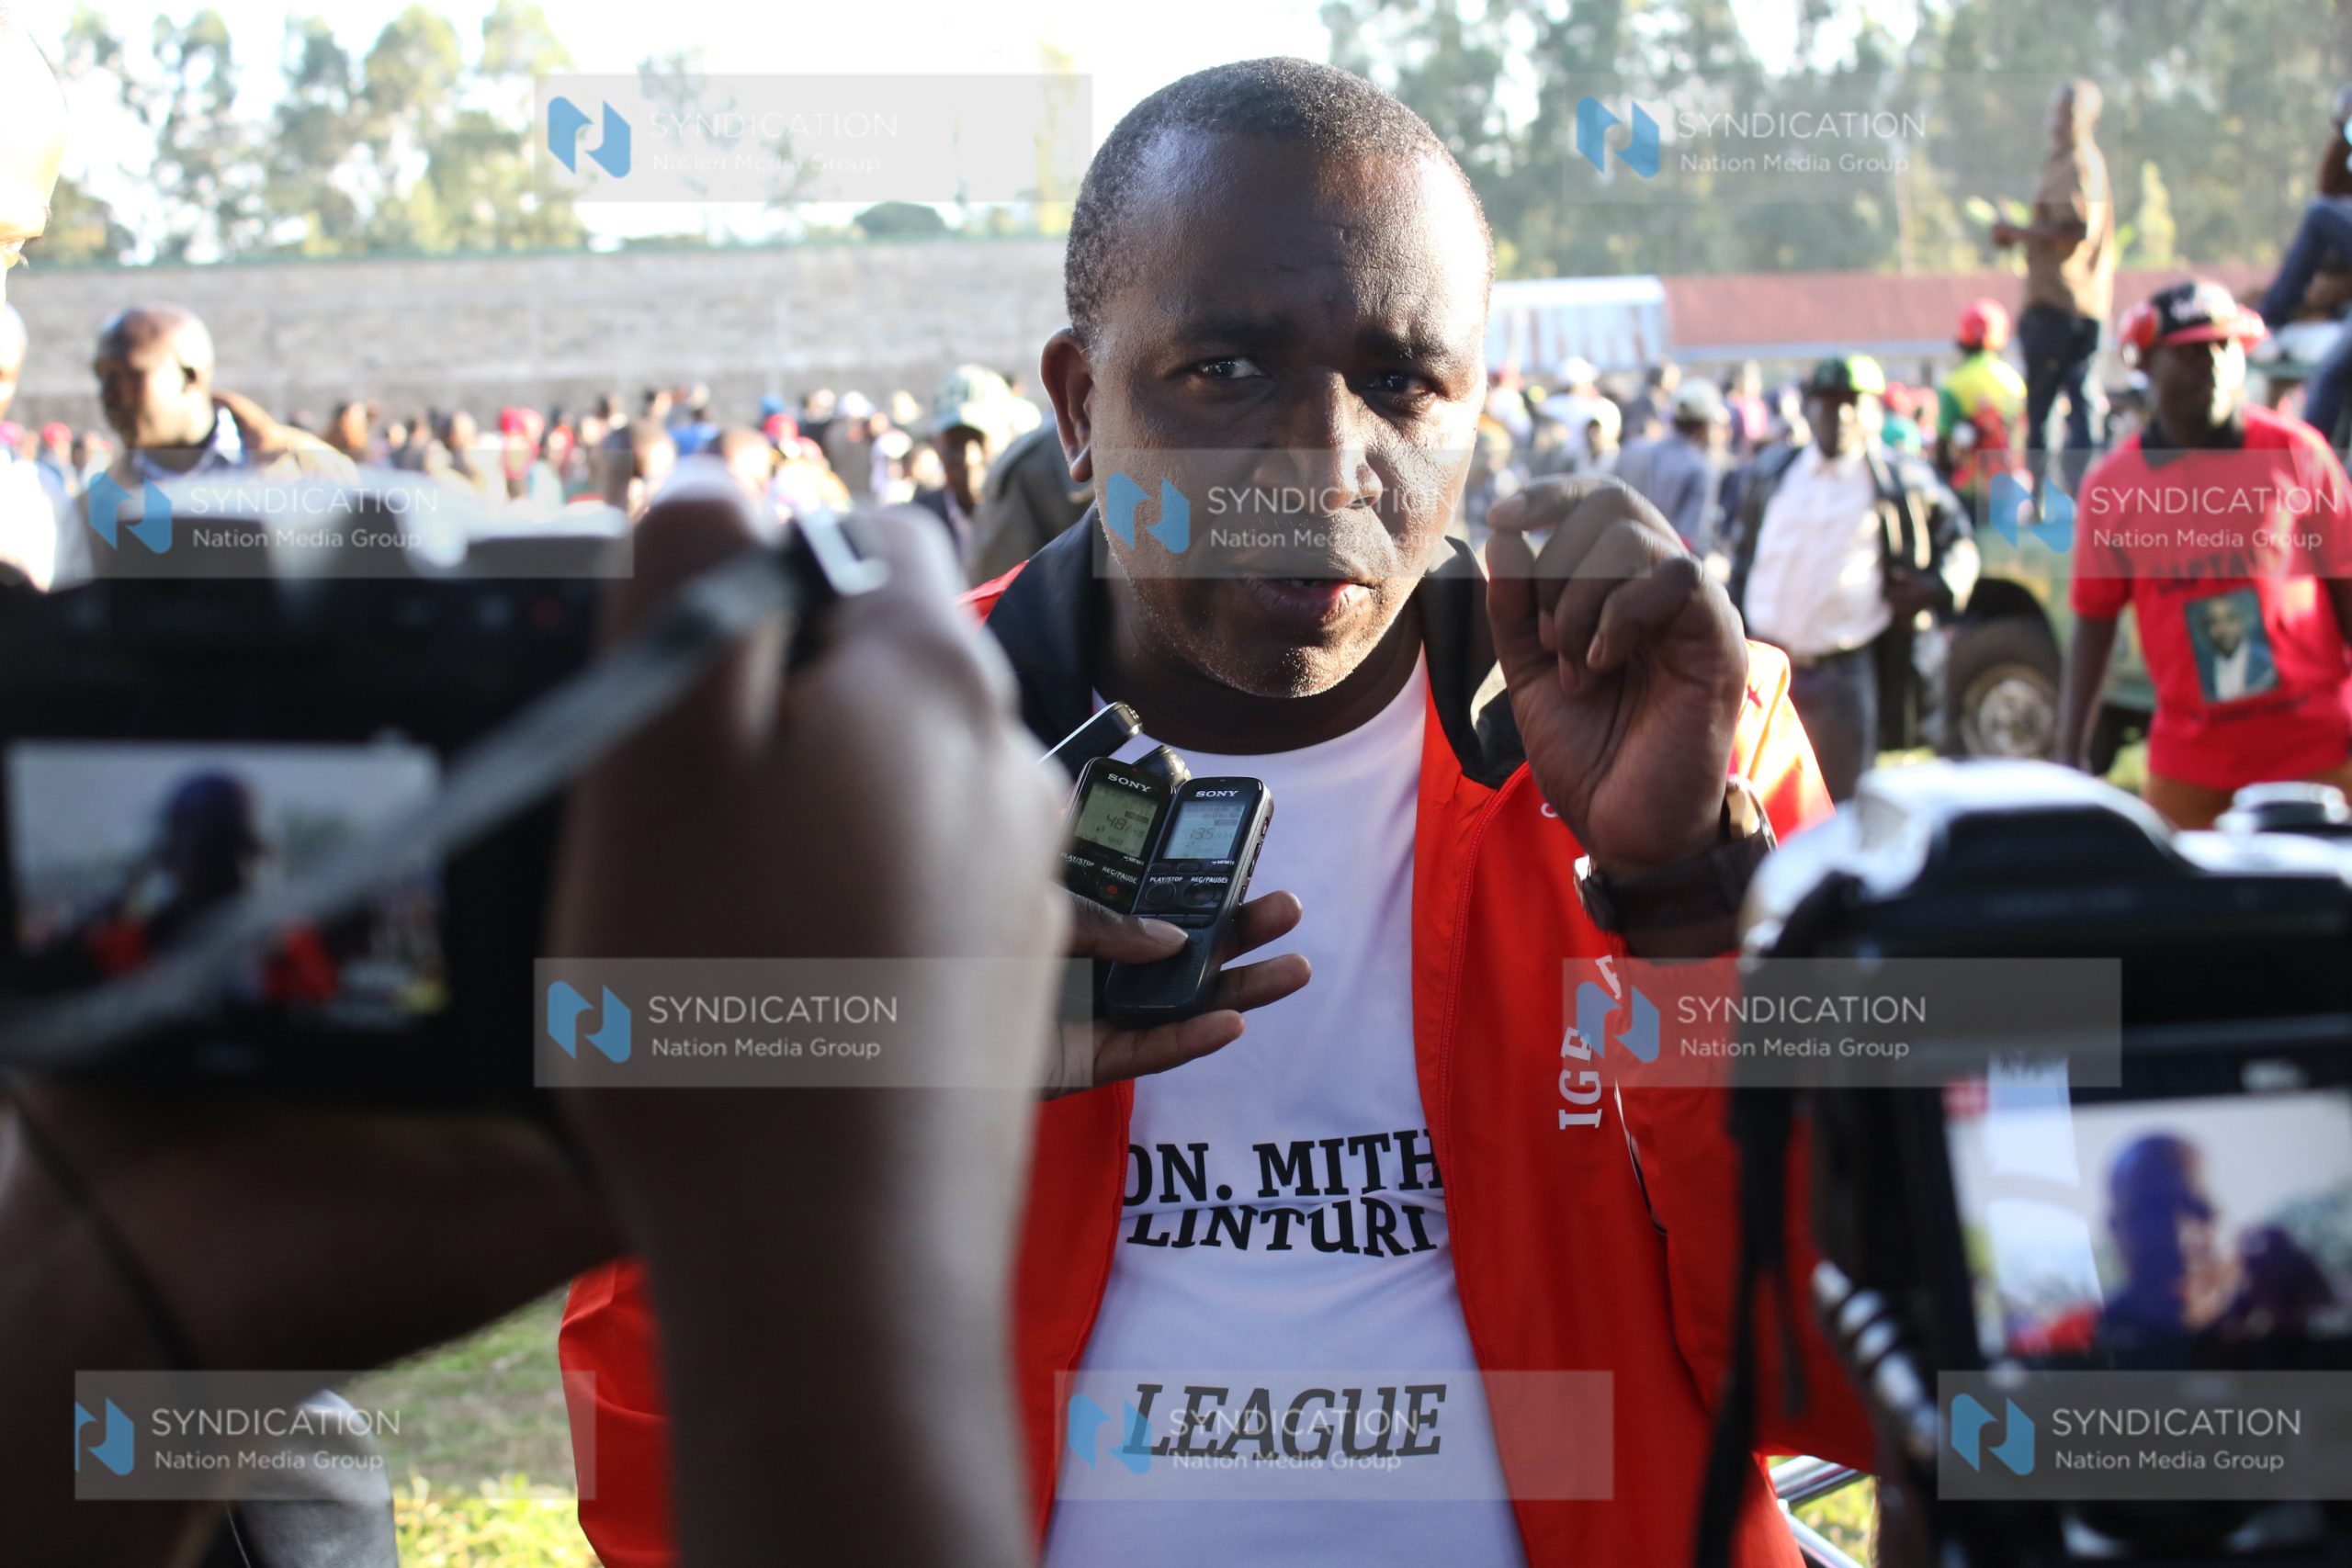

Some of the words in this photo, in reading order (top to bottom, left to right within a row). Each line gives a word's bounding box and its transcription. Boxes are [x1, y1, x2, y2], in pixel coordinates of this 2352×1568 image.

[1107, 773, 1152, 792] SONY
[1195, 790, 1238, 798] SONY
[1102, 866, 1138, 884] REC/PAUSE
[1126, 1196, 1438, 1258] LINTURI
[1122, 1383, 1447, 1461] LEAGUE
